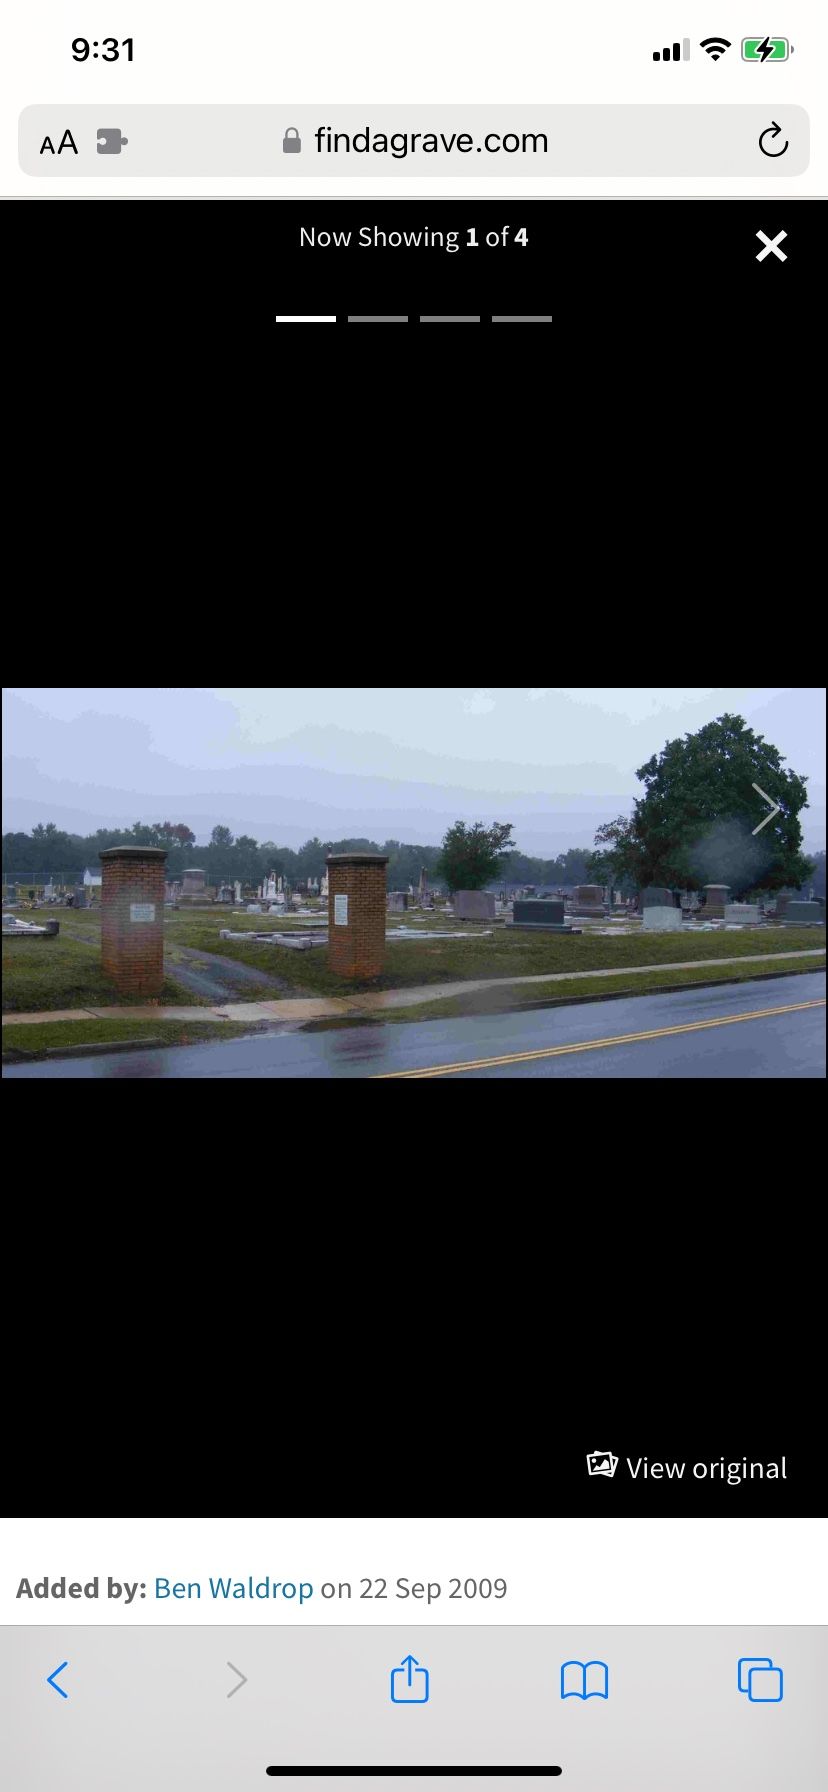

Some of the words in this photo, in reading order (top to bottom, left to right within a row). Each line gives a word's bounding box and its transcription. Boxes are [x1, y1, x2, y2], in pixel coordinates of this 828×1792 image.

[71, 37, 134, 63] 9:31
[314, 126, 549, 160] findagrave.com
[300, 227, 352, 248] Now
[358, 225, 460, 253] Showing
[466, 227, 480, 247] 1
[485, 225, 509, 248] of
[514, 227, 529, 247] 4
[626, 1456, 686, 1480] View
[692, 1455, 788, 1486] original
[15, 1576, 99, 1600] Added
[107, 1576, 147, 1605] by:
[155, 1577, 201, 1600] Ben
[208, 1575, 314, 1605] Waldrop
[320, 1582, 352, 1600] on
[359, 1577, 388, 1599] 22
[395, 1577, 442, 1605] Sep
[448, 1577, 508, 1600] 2009
